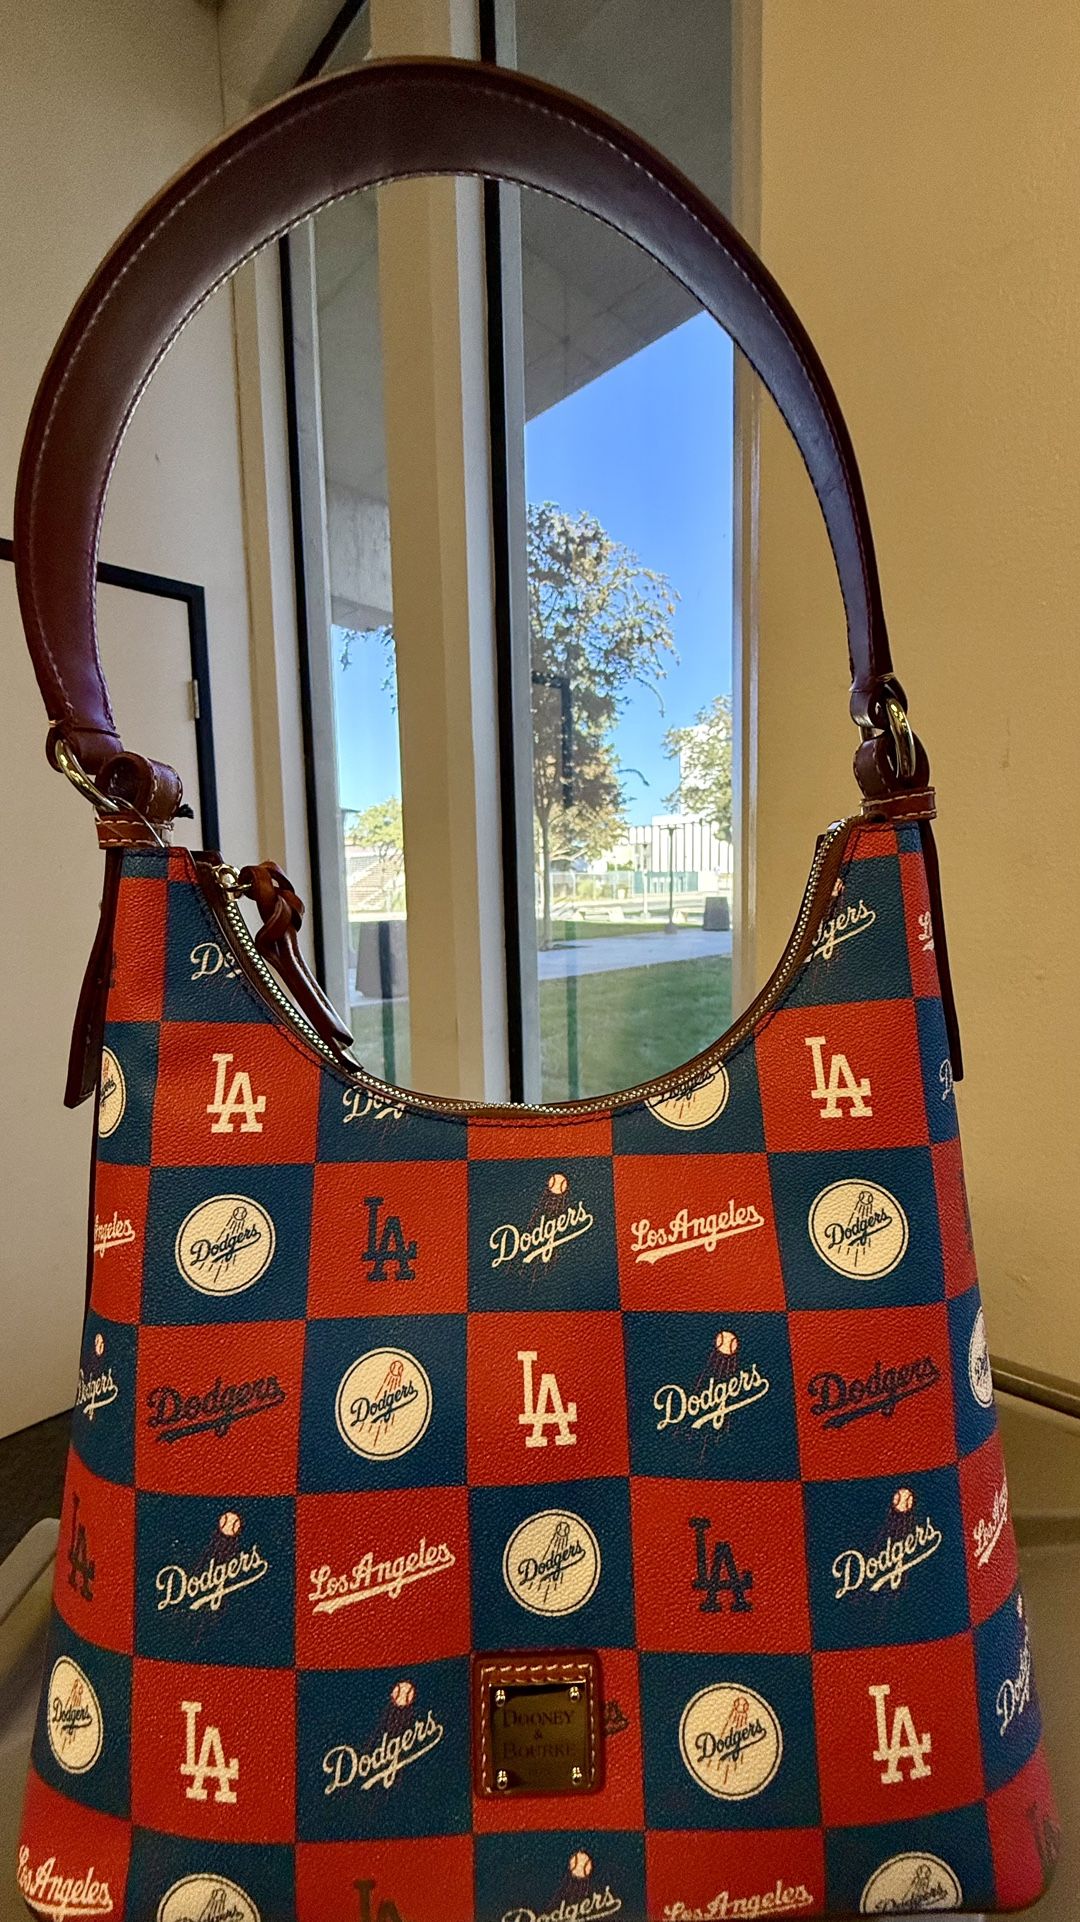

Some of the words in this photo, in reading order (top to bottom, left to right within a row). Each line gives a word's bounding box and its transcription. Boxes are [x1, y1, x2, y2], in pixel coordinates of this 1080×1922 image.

[206, 1053, 266, 1133] LA
[804, 1036, 874, 1119] LA
[190, 1225, 262, 1266] Dodgers
[363, 1196, 418, 1282] LA
[489, 1201, 594, 1268] Dodgers
[631, 1217, 668, 1252] Los
[664, 1200, 765, 1252] Angeles
[824, 1206, 893, 1250] Dodgers
[146, 1374, 287, 1444] Dodgers
[350, 1382, 419, 1427] Dodgers
[517, 1351, 578, 1448] LA
[654, 1363, 770, 1431] Dodgers
[806, 1354, 941, 1431] Dodgers
[156, 1545, 268, 1611] Dodgers
[309, 1567, 352, 1602] Los
[348, 1538, 456, 1600] Angeles
[518, 1540, 586, 1586] Dodgers
[690, 1517, 753, 1613] LA
[832, 1517, 942, 1600] Dodgers
[52, 1696, 93, 1735] Dodgers
[695, 1718, 768, 1763] Dodgers
[868, 1684, 932, 1785] LA
[180, 1701, 239, 1804] LA
[322, 1711, 444, 1796] Dodgers
[35, 1856, 114, 1922] Angeles
[702, 1879, 814, 1919] Angeles
